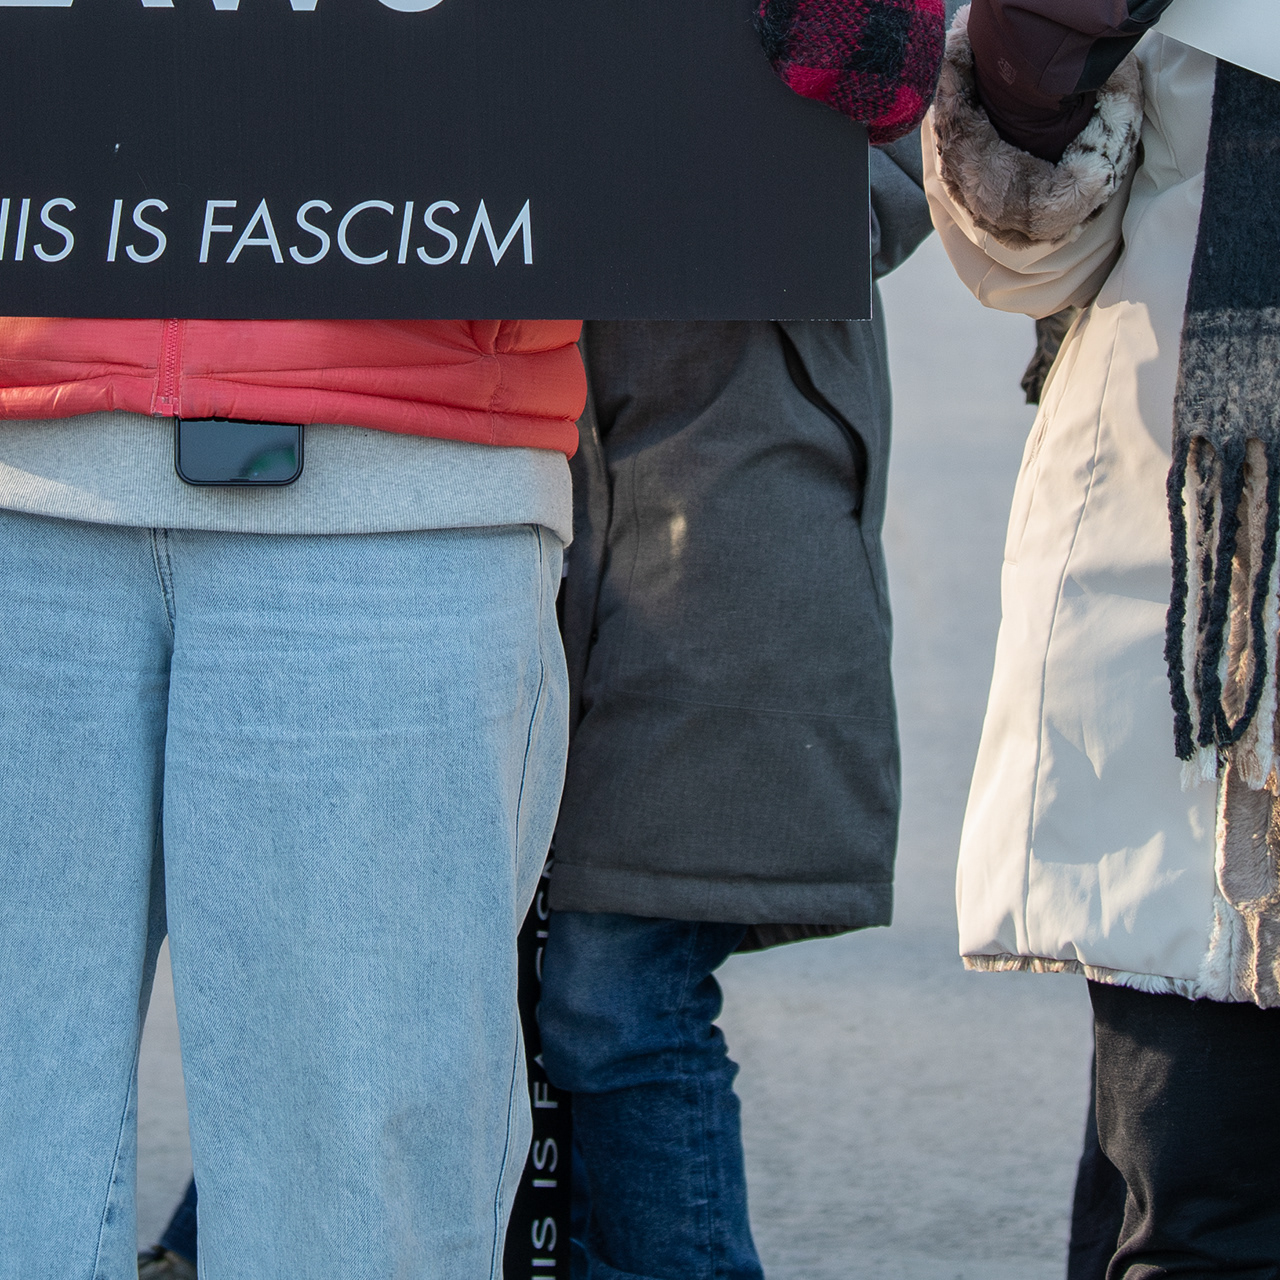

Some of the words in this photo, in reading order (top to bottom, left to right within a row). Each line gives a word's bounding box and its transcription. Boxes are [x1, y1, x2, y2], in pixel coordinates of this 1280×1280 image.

[106, 198, 169, 264] IS
[198, 197, 534, 267] FASCISM
[531, 1137, 559, 1188] IS
[531, 1216, 559, 1280] IS
